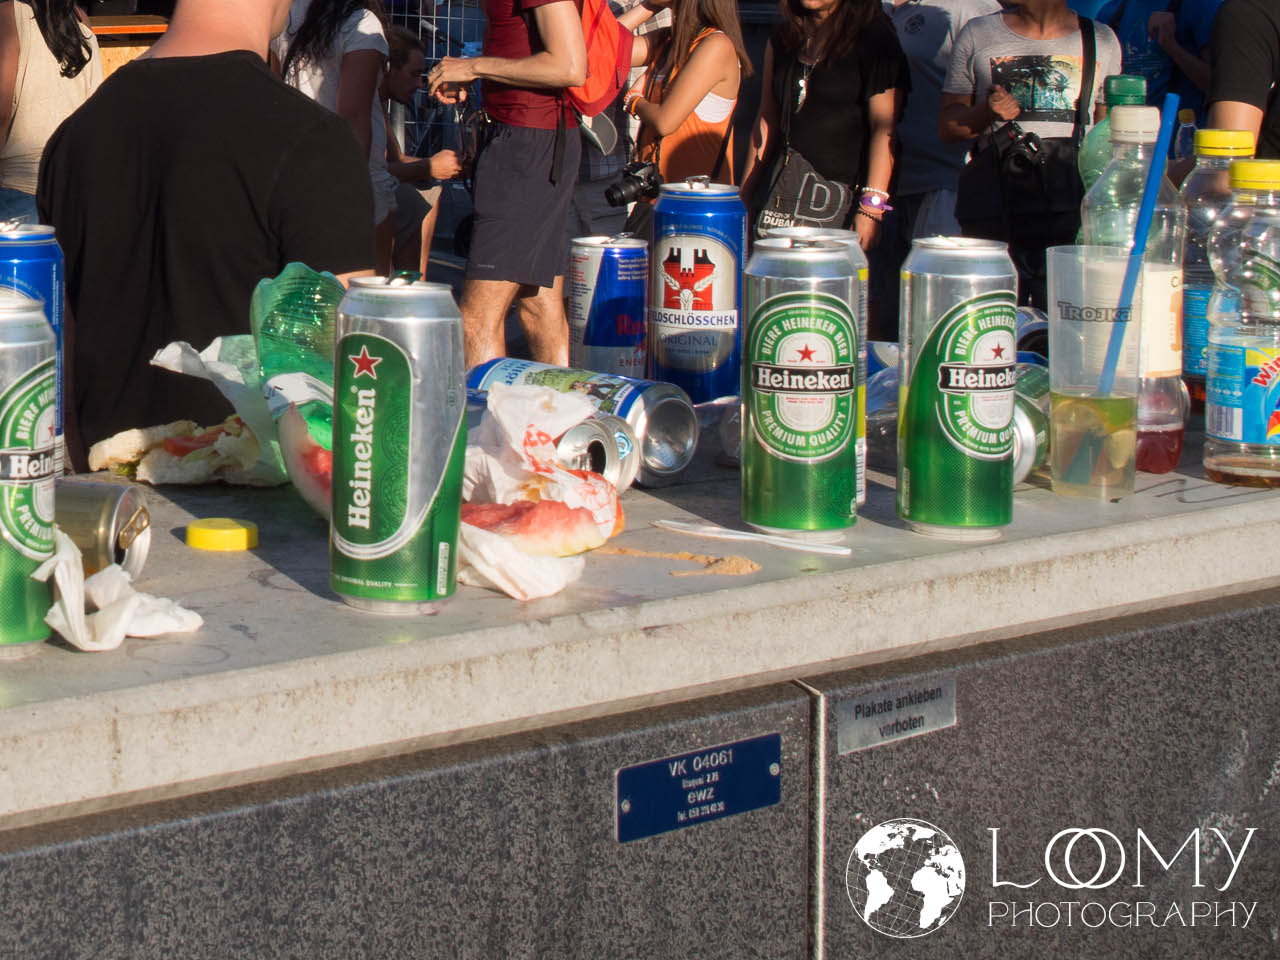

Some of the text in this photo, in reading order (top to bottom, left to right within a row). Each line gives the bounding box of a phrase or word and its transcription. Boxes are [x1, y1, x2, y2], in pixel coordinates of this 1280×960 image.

[763, 215, 795, 227] DUBAI
[781, 316, 838, 333] HEINEKEN
[761, 325, 783, 355] BIERE
[954, 325, 979, 356] BIERE
[757, 367, 850, 390] Heineken
[15, 401, 40, 440] BIERE
[761, 409, 807, 447] PREMIUM
[809, 411, 846, 447] QUALITY
[954, 410, 998, 444] PREMIUM
[347, 385, 376, 529] Heineken
[854, 687, 943, 720] Plakate ankleben
[878, 714, 925, 738] verboten
[668, 748, 734, 777] VK 04061
[687, 787, 715, 804] ewz
